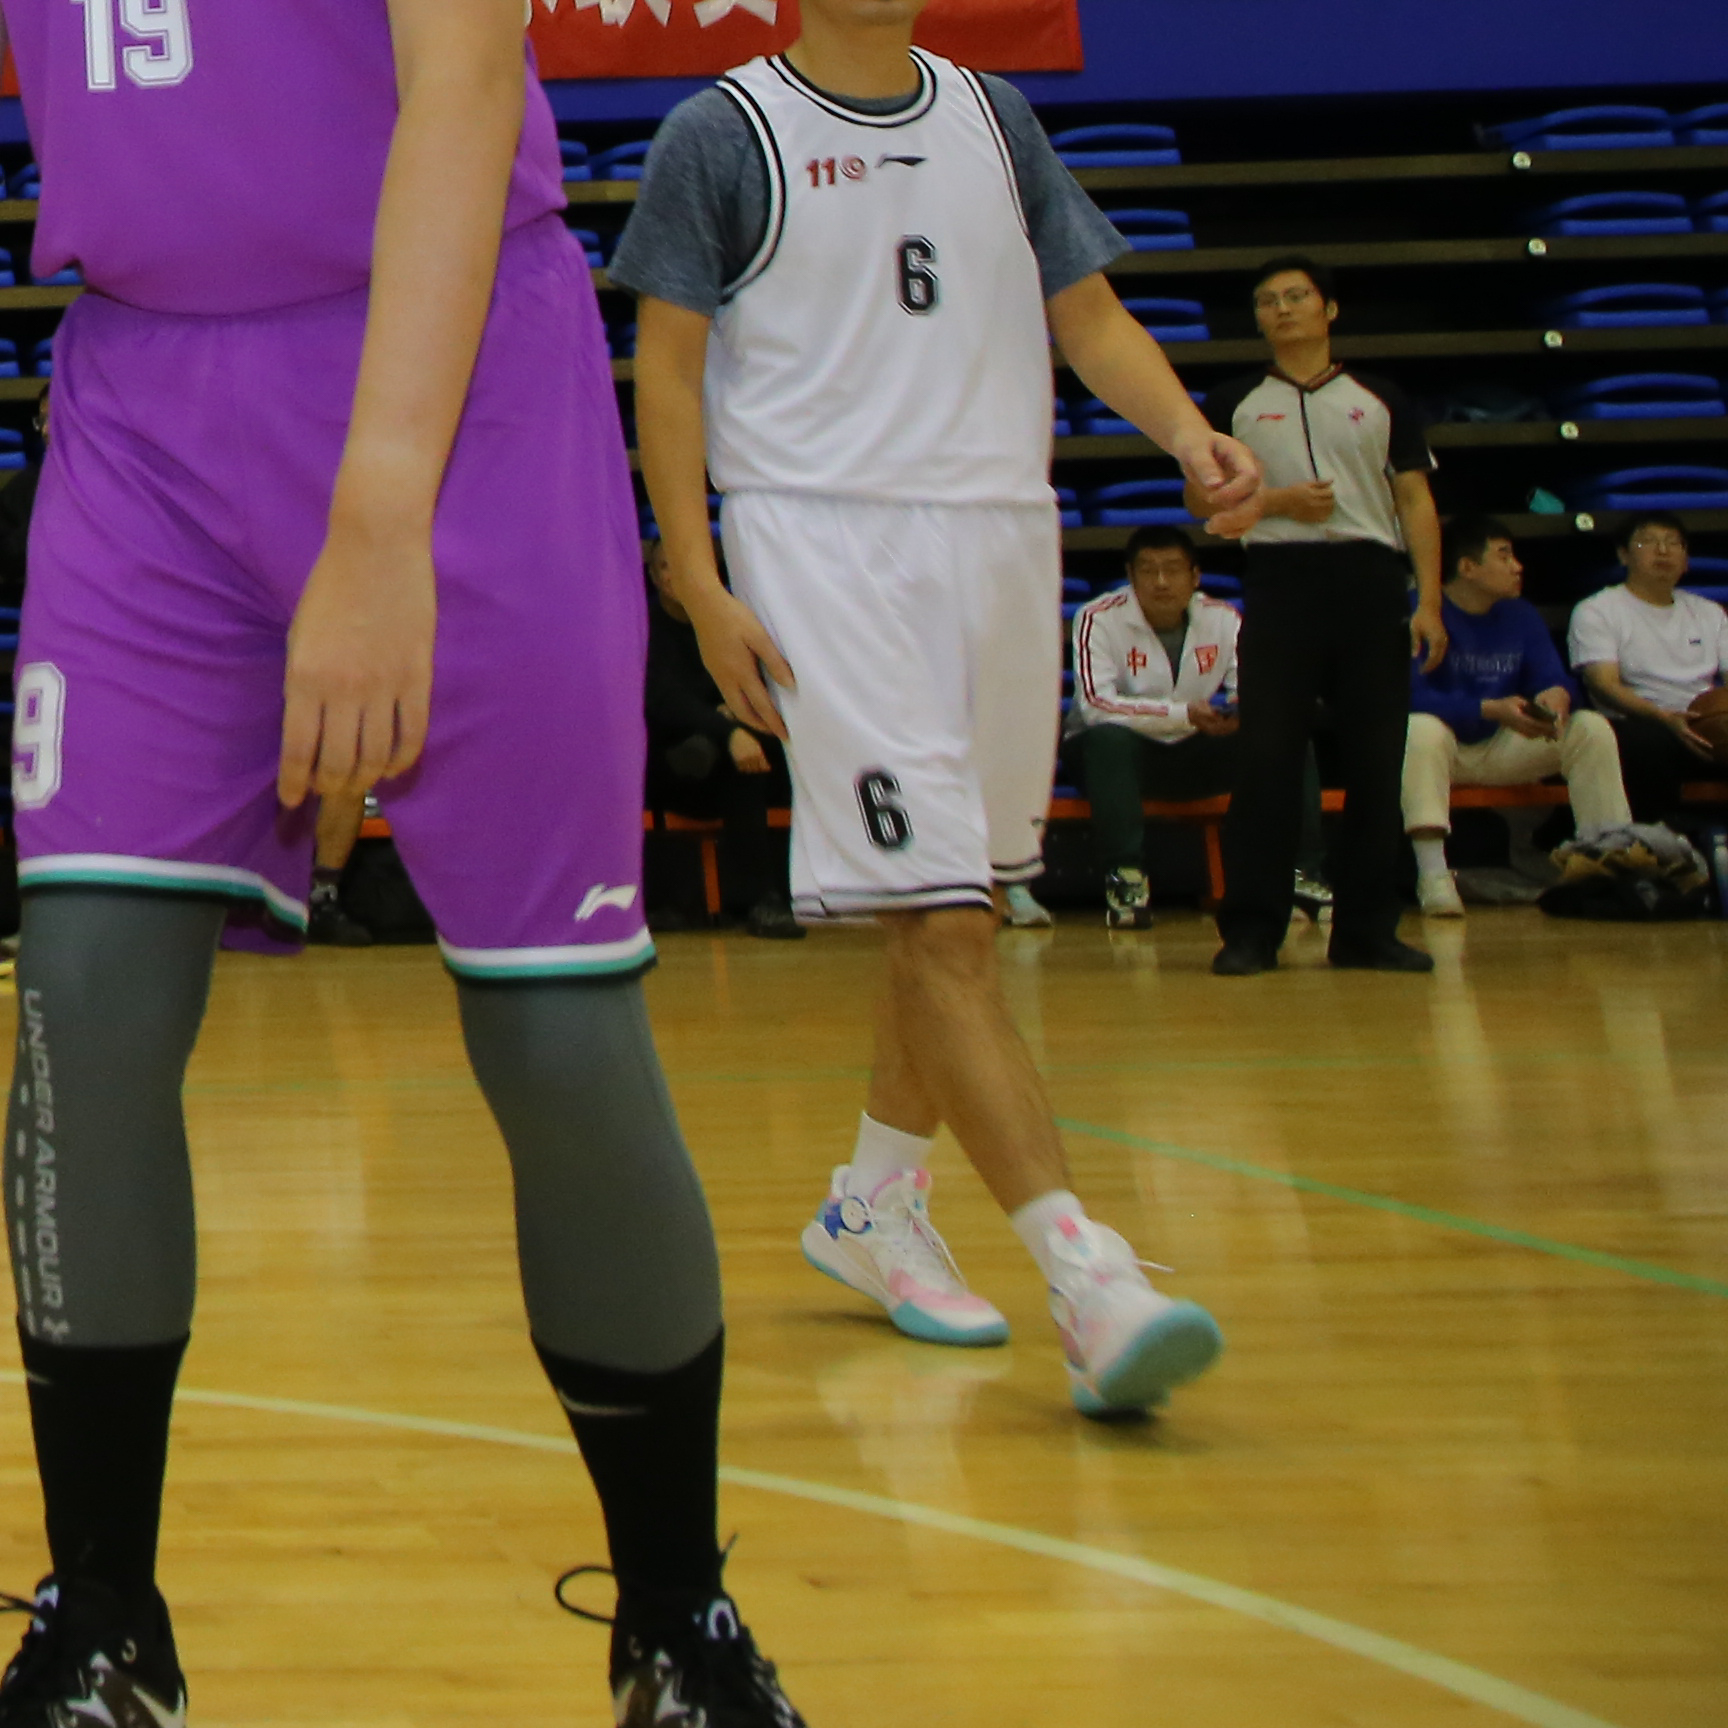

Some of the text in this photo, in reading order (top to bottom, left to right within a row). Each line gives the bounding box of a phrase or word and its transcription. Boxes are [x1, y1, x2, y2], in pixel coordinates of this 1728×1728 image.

[896, 234, 939, 316] 6
[854, 768, 915, 851] 6
[23, 988, 65, 1310] UNDER ARMOUR
